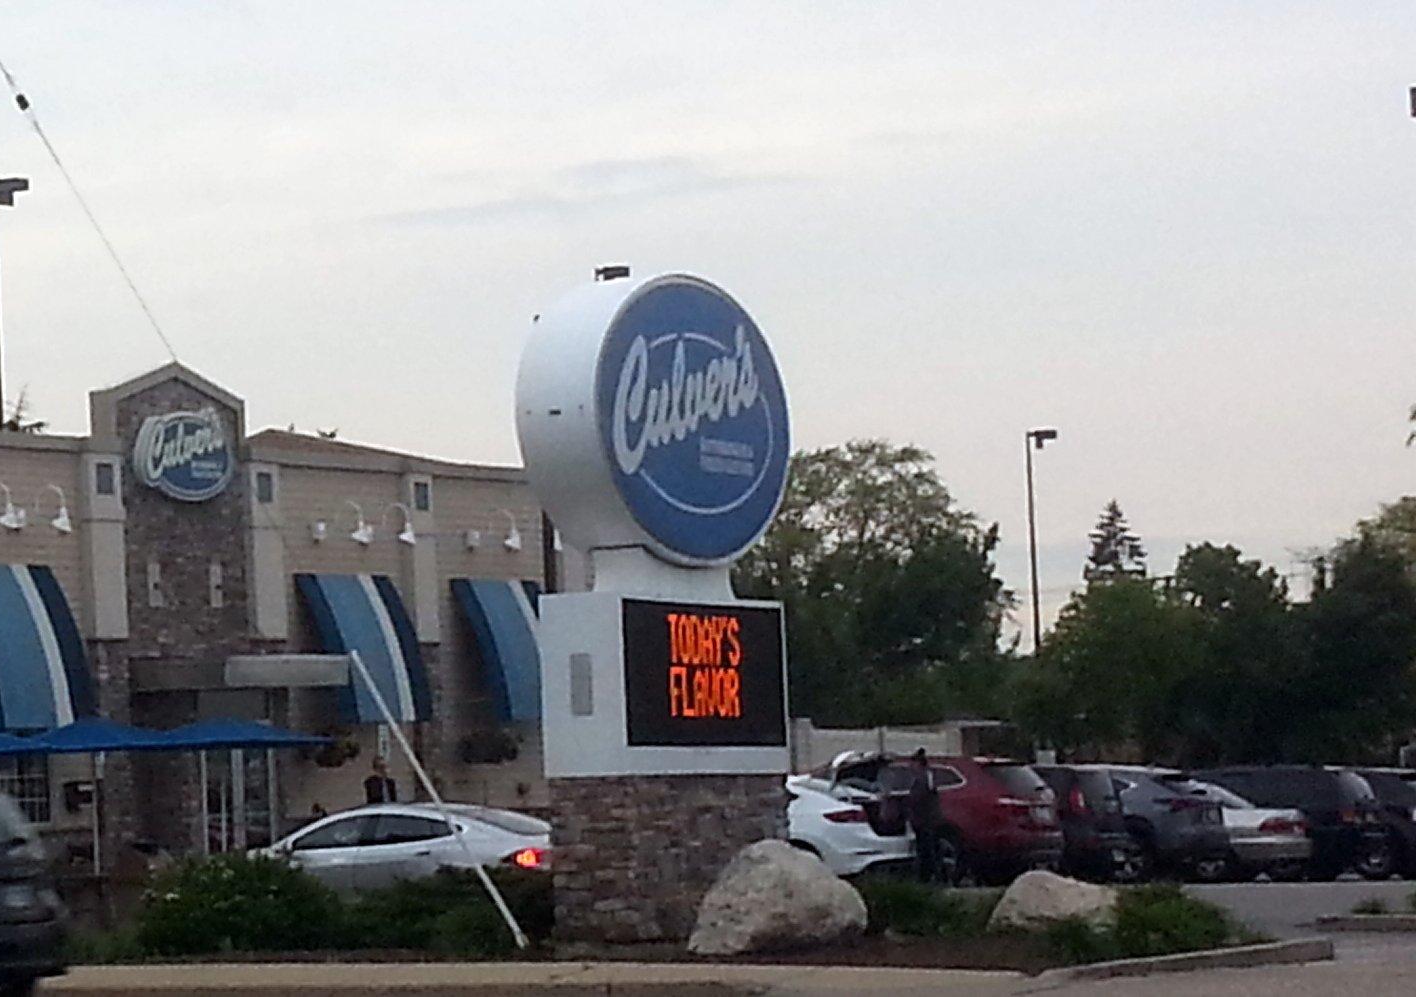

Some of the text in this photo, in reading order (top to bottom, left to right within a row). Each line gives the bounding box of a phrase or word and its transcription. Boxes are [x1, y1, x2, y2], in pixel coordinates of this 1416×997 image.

[613, 325, 758, 475] Culver's
[667, 614, 741, 666] TODAY'S
[670, 666, 741, 718] FLAVOR
